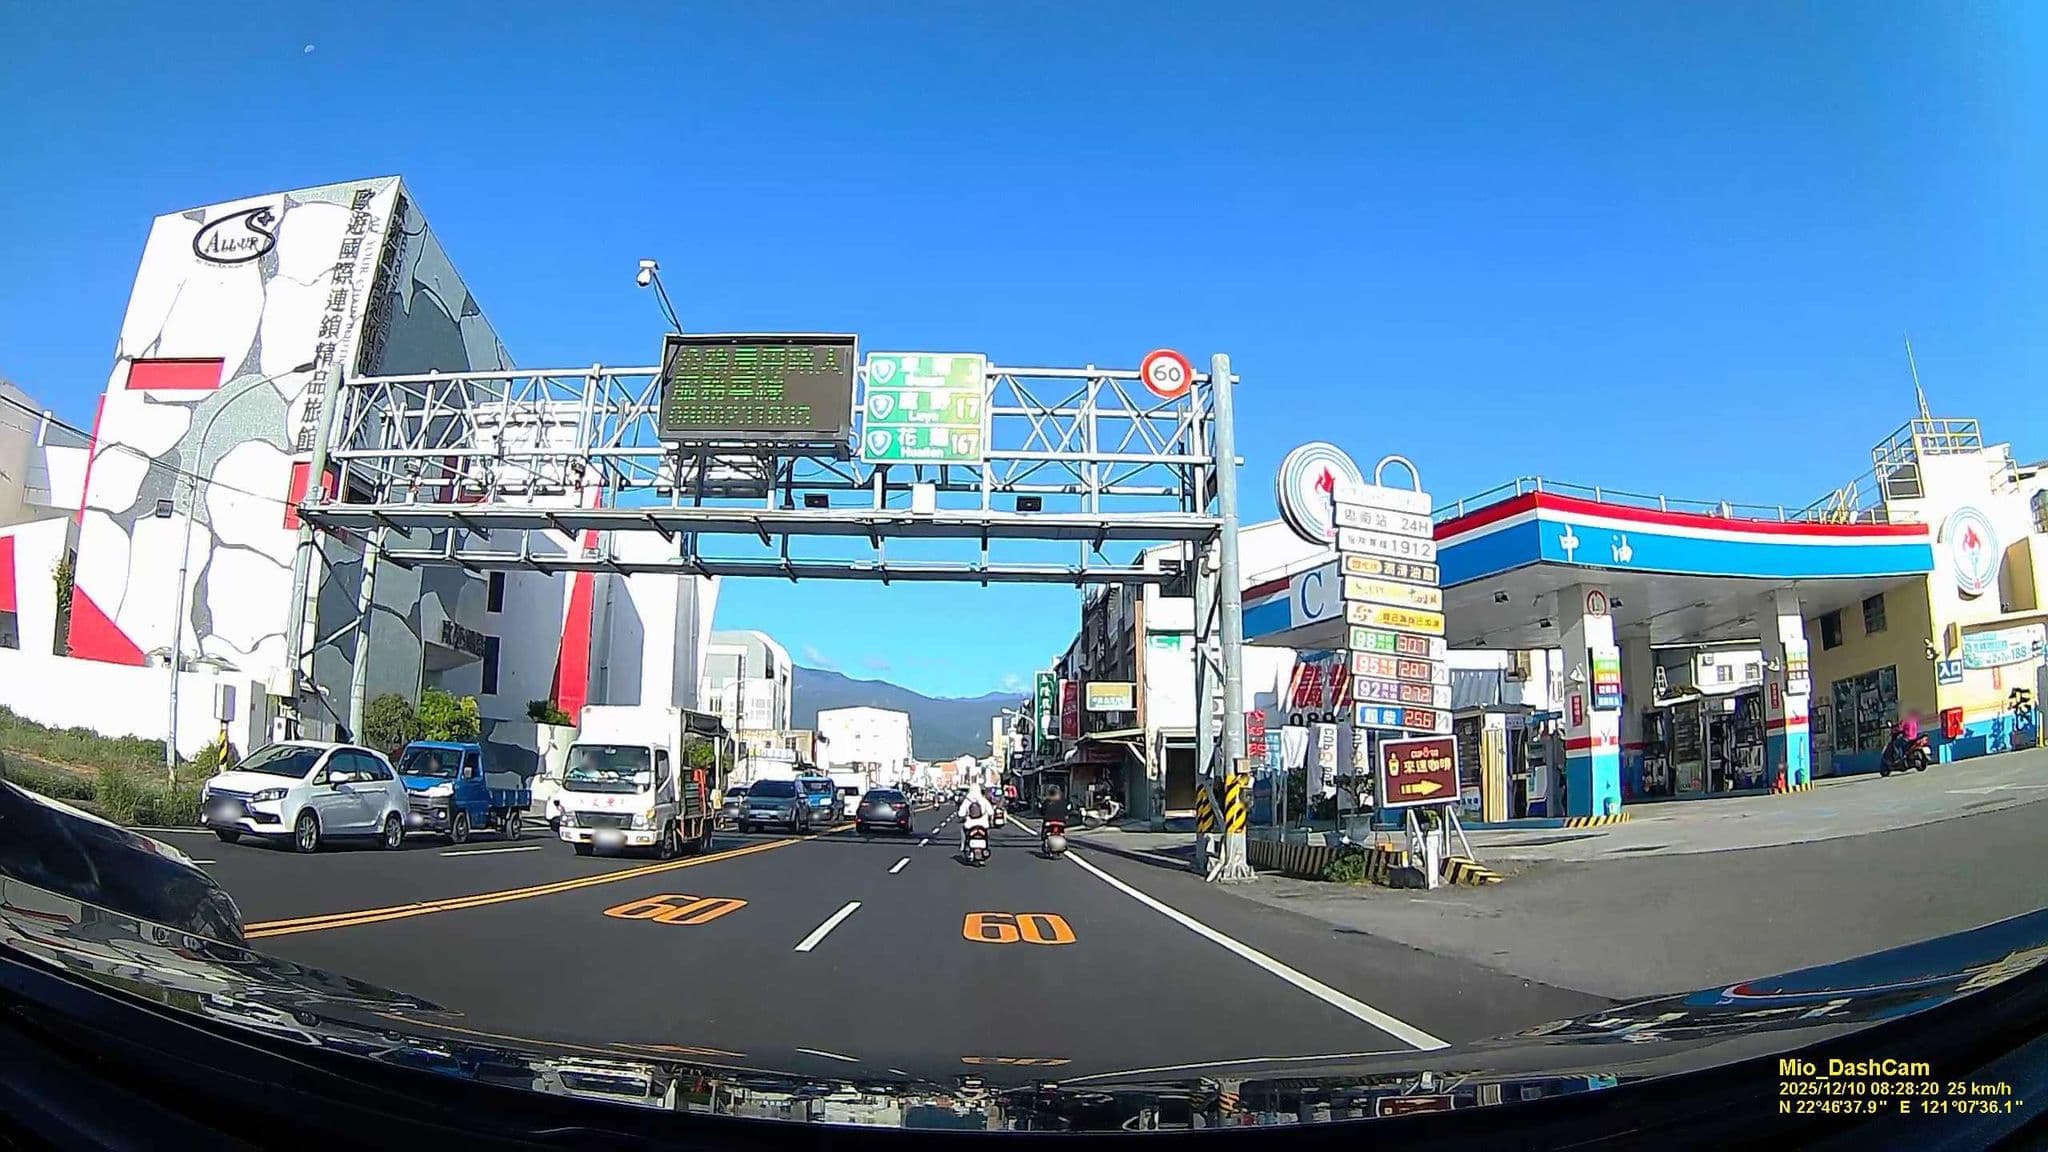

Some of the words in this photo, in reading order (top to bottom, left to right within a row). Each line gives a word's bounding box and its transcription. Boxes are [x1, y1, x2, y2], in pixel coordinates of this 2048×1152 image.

[1153, 364, 1181, 382] 60
[957, 398, 980, 419] 17
[951, 433, 980, 455] 167
[1401, 517, 1429, 534] 24H
[1392, 539, 1431, 557] 1912
[1559, 523, 1633, 564] 中油
[1355, 631, 1376, 647] 98
[1940, 661, 1961, 678] 入口
[1360, 680, 1380, 697] 92
[602, 893, 749, 925] 60
[963, 911, 1077, 945] 60
